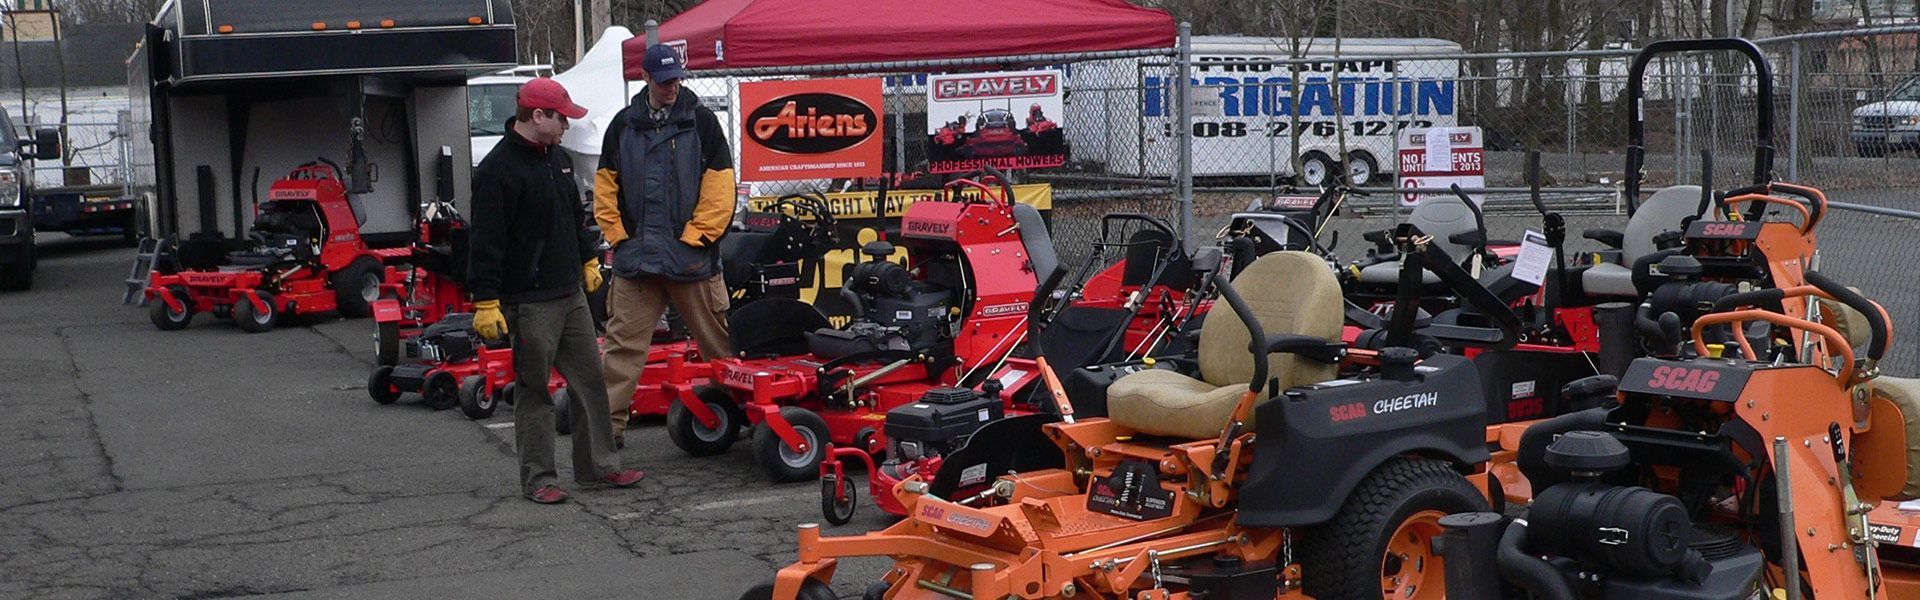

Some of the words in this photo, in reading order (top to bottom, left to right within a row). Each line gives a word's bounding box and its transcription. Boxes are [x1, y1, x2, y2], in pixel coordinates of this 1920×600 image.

[938, 76, 1052, 98] GRAVELY
[753, 100, 868, 140] Ariens
[1165, 121, 1432, 138] 08-276-127
[929, 158, 1013, 172] PROFESSIONAL
[1015, 154, 1064, 169] MOWERS
[1402, 154, 1419, 164] NO
[1421, 152, 1481, 164] ENTS
[1402, 164, 1425, 173] UNTI
[1460, 162, 1481, 171] 2013
[908, 221, 949, 233] GRAVELY
[1703, 223, 1745, 236] SCAG
[190, 275, 225, 284] GRAVELY
[985, 304, 1026, 315] GRAVELY
[1648, 366, 1720, 393] SCAG
[1330, 402, 1367, 421] SCAG
[1373, 392, 1438, 414] CHEETAH
[922, 505, 945, 520] SCAG
[1869, 525, 1900, 535] vy-Duty
[1872, 534, 1899, 542] ercial
